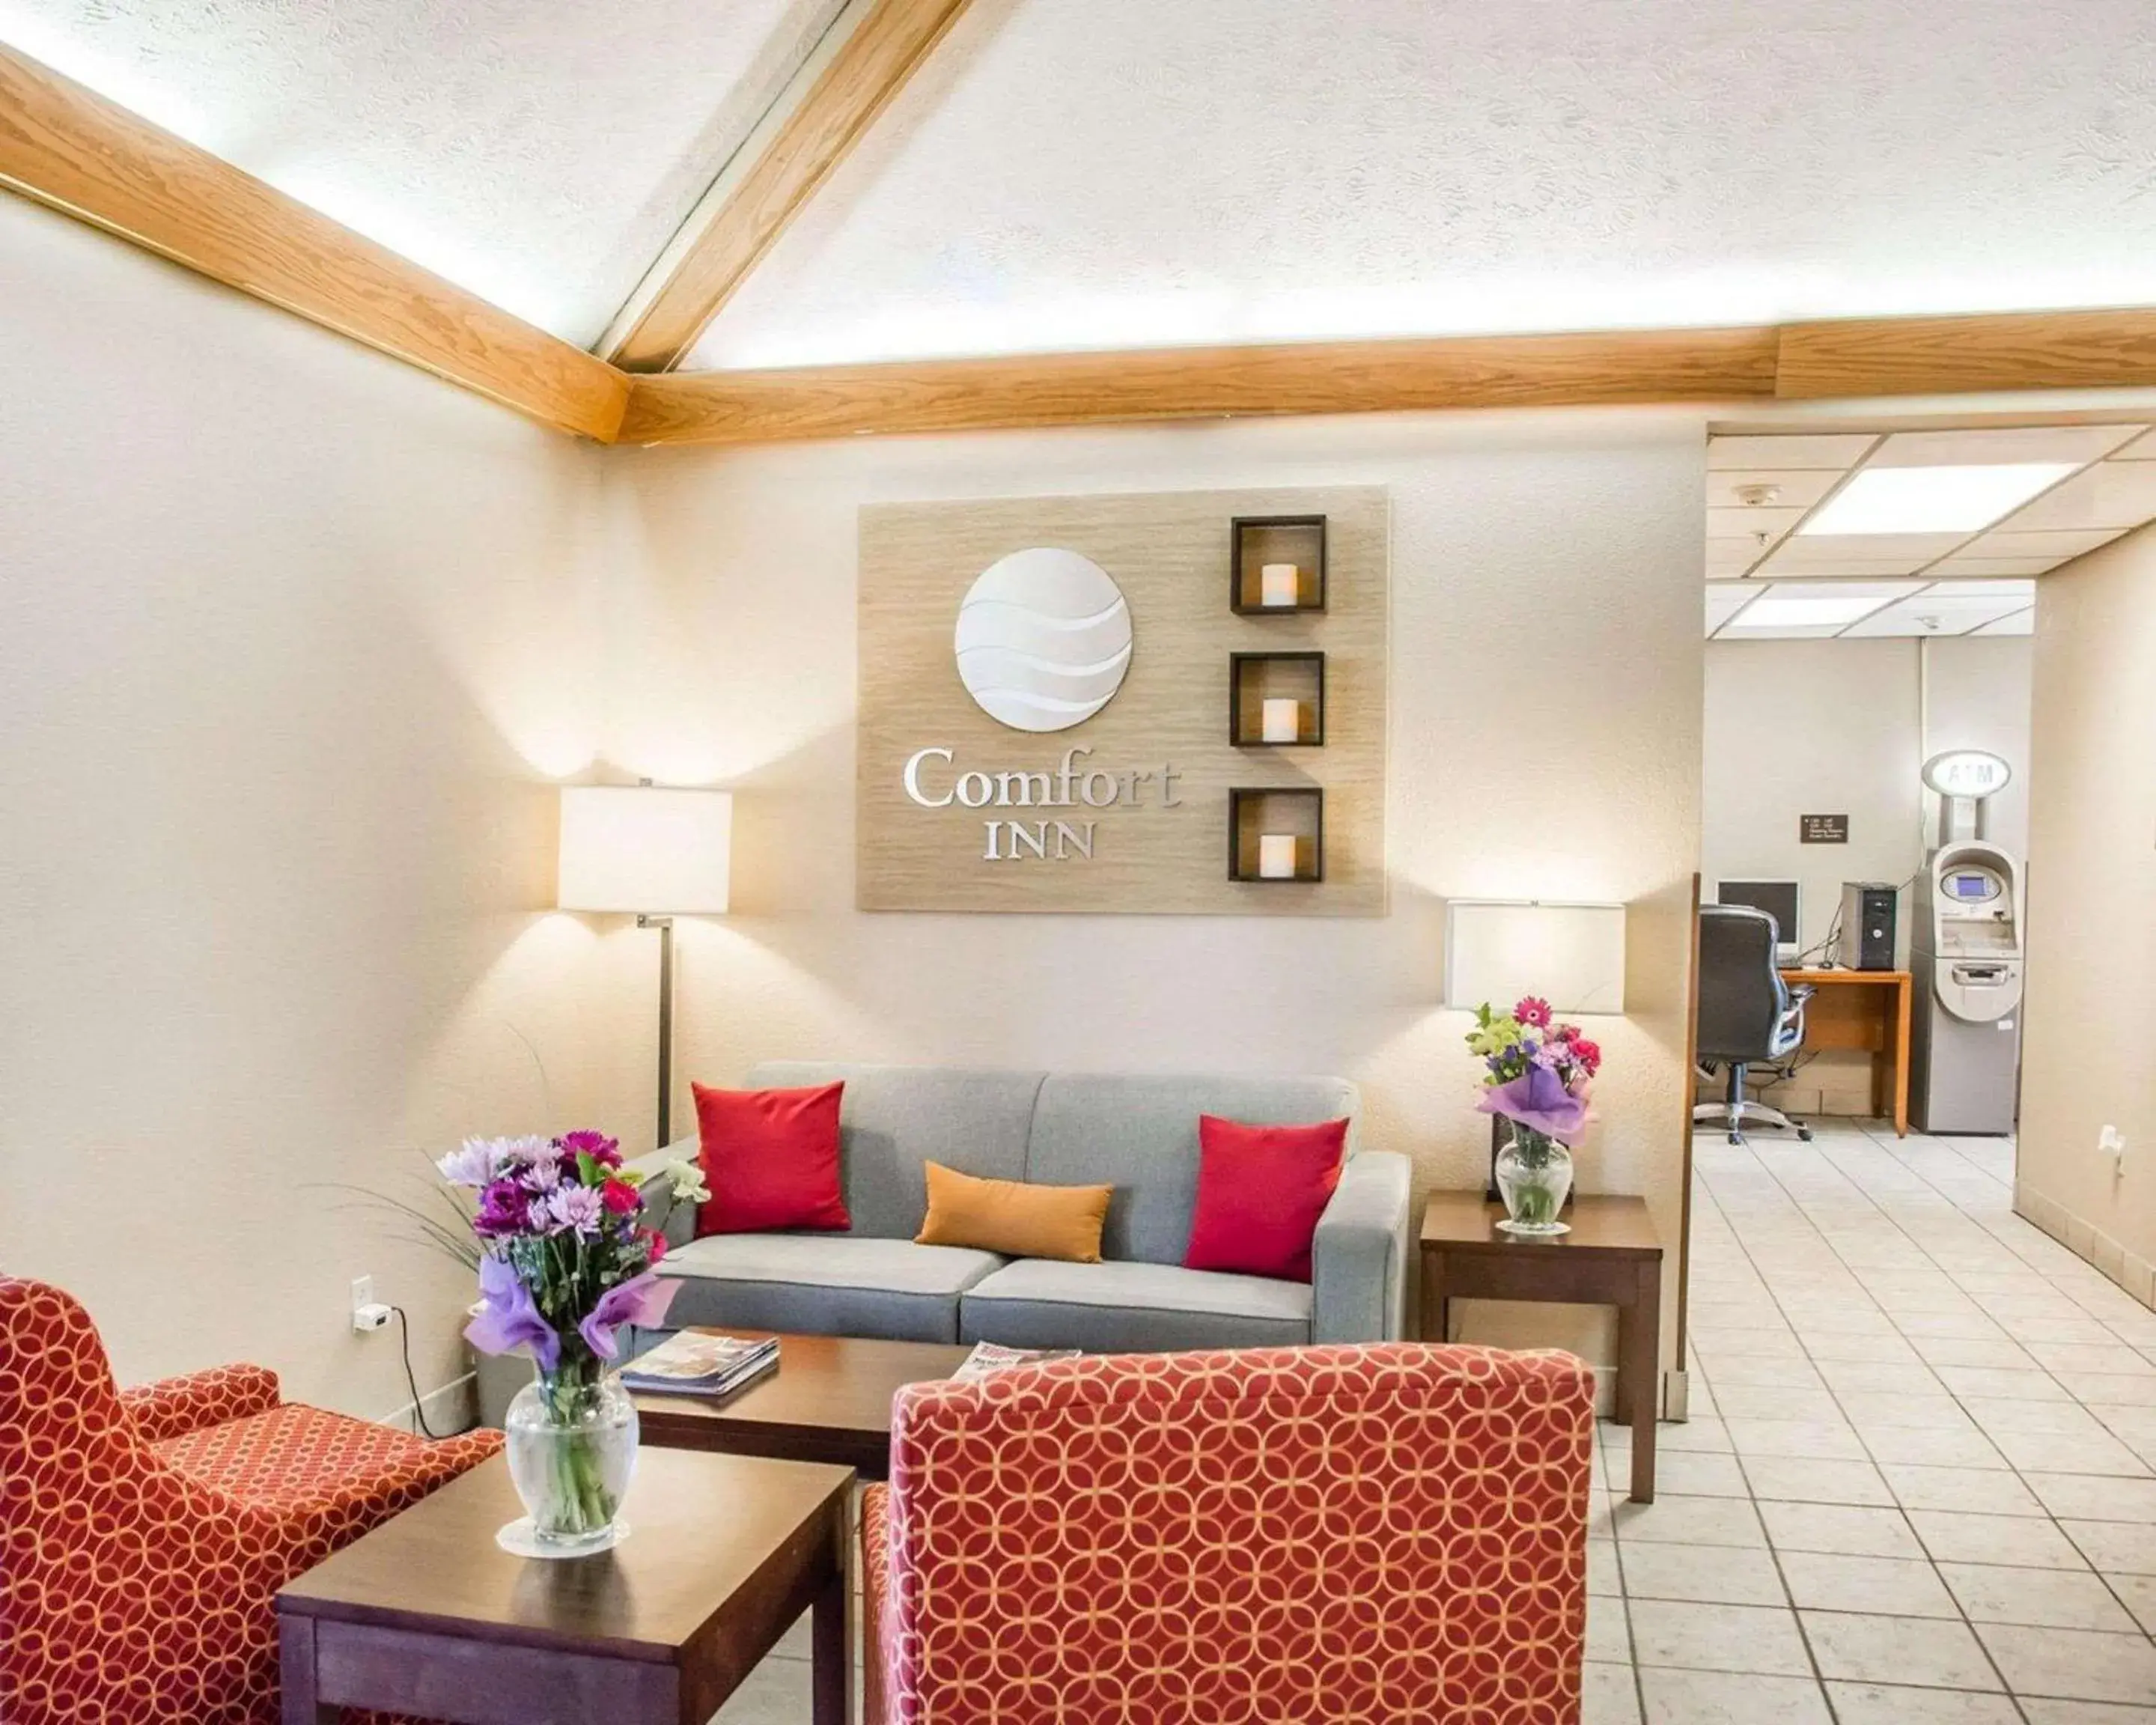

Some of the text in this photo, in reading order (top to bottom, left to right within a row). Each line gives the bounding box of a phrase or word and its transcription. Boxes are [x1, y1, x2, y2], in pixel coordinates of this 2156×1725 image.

[903, 747, 1182, 807] Comfort
[1948, 764, 1993, 783] AM
[983, 821, 1097, 860] INN
